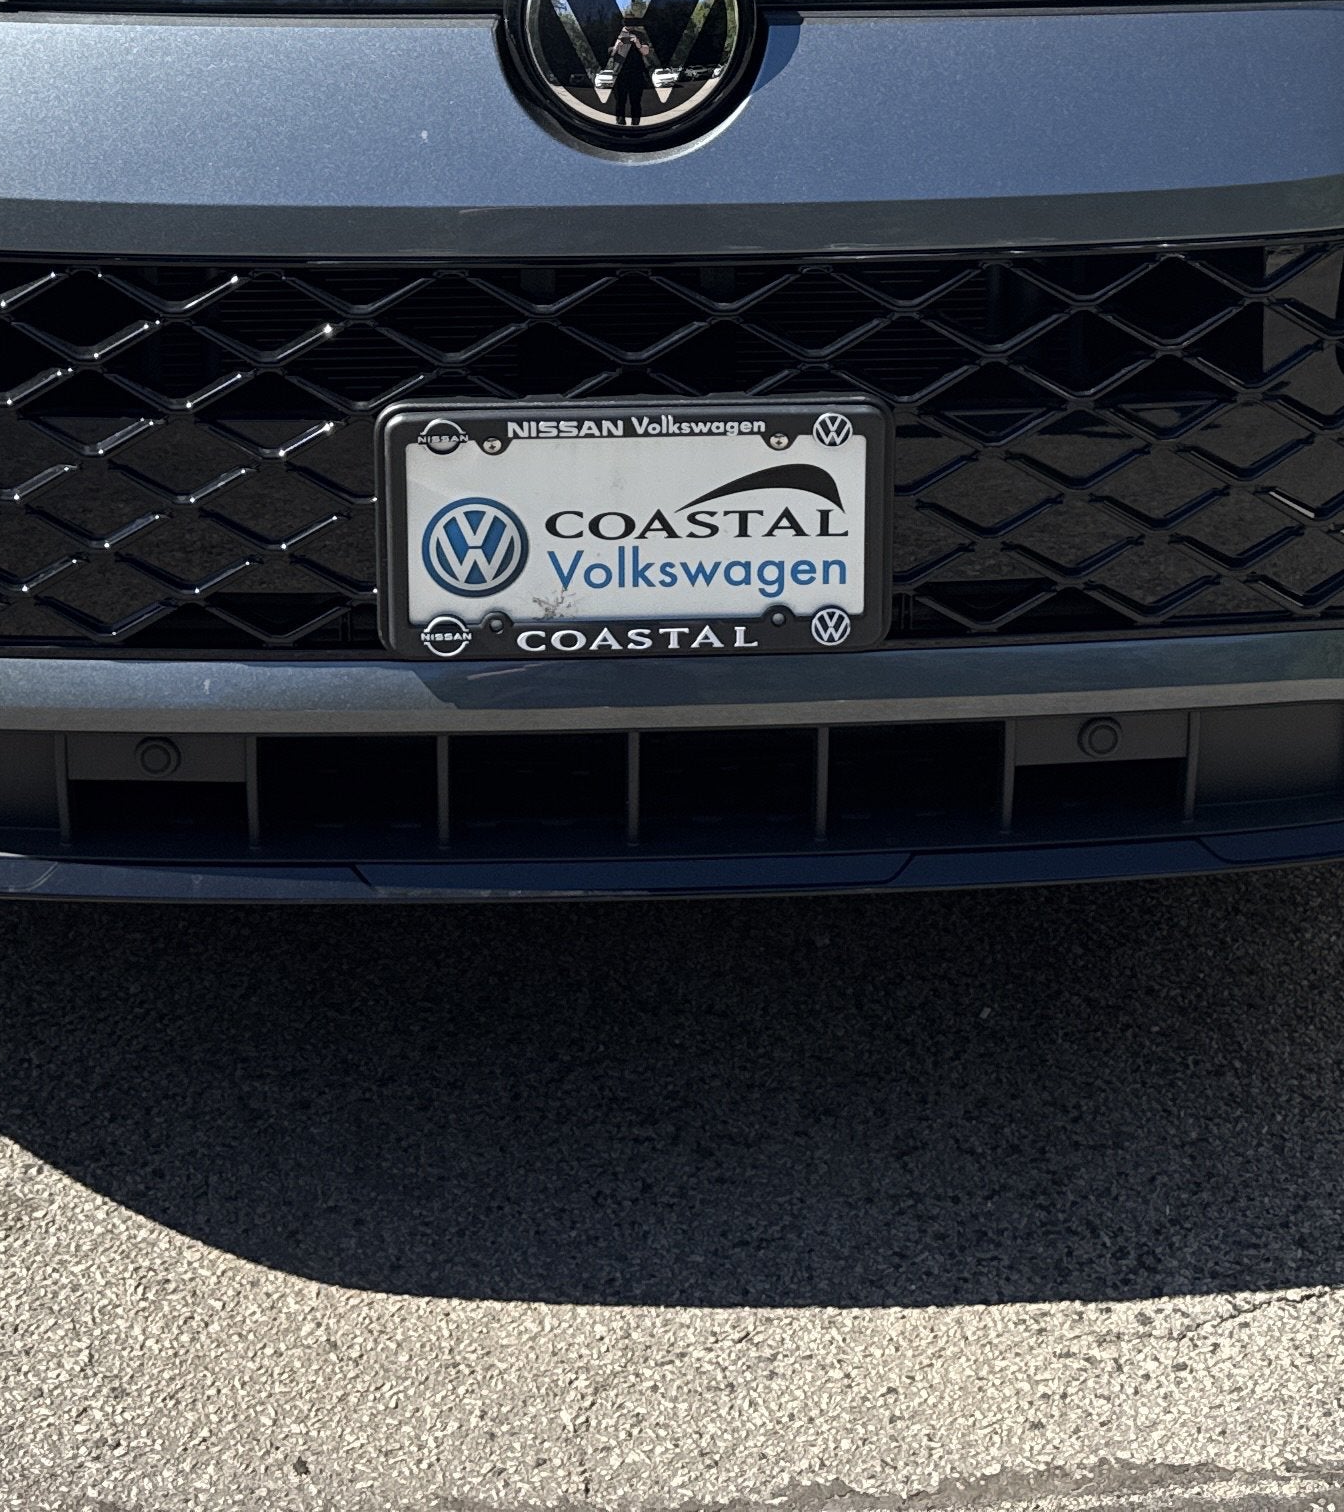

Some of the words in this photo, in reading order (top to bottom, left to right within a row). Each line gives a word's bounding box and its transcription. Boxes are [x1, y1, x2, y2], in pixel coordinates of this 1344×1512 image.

[507, 420, 624, 438] NISSAN
[631, 414, 766, 436] Volkswagen
[417, 434, 469, 444] NISSAN
[545, 506, 849, 541] COASTAL
[547, 545, 847, 598] Volkswagen
[420, 632, 472, 641] NISSAN
[516, 625, 758, 652] COASTAL
